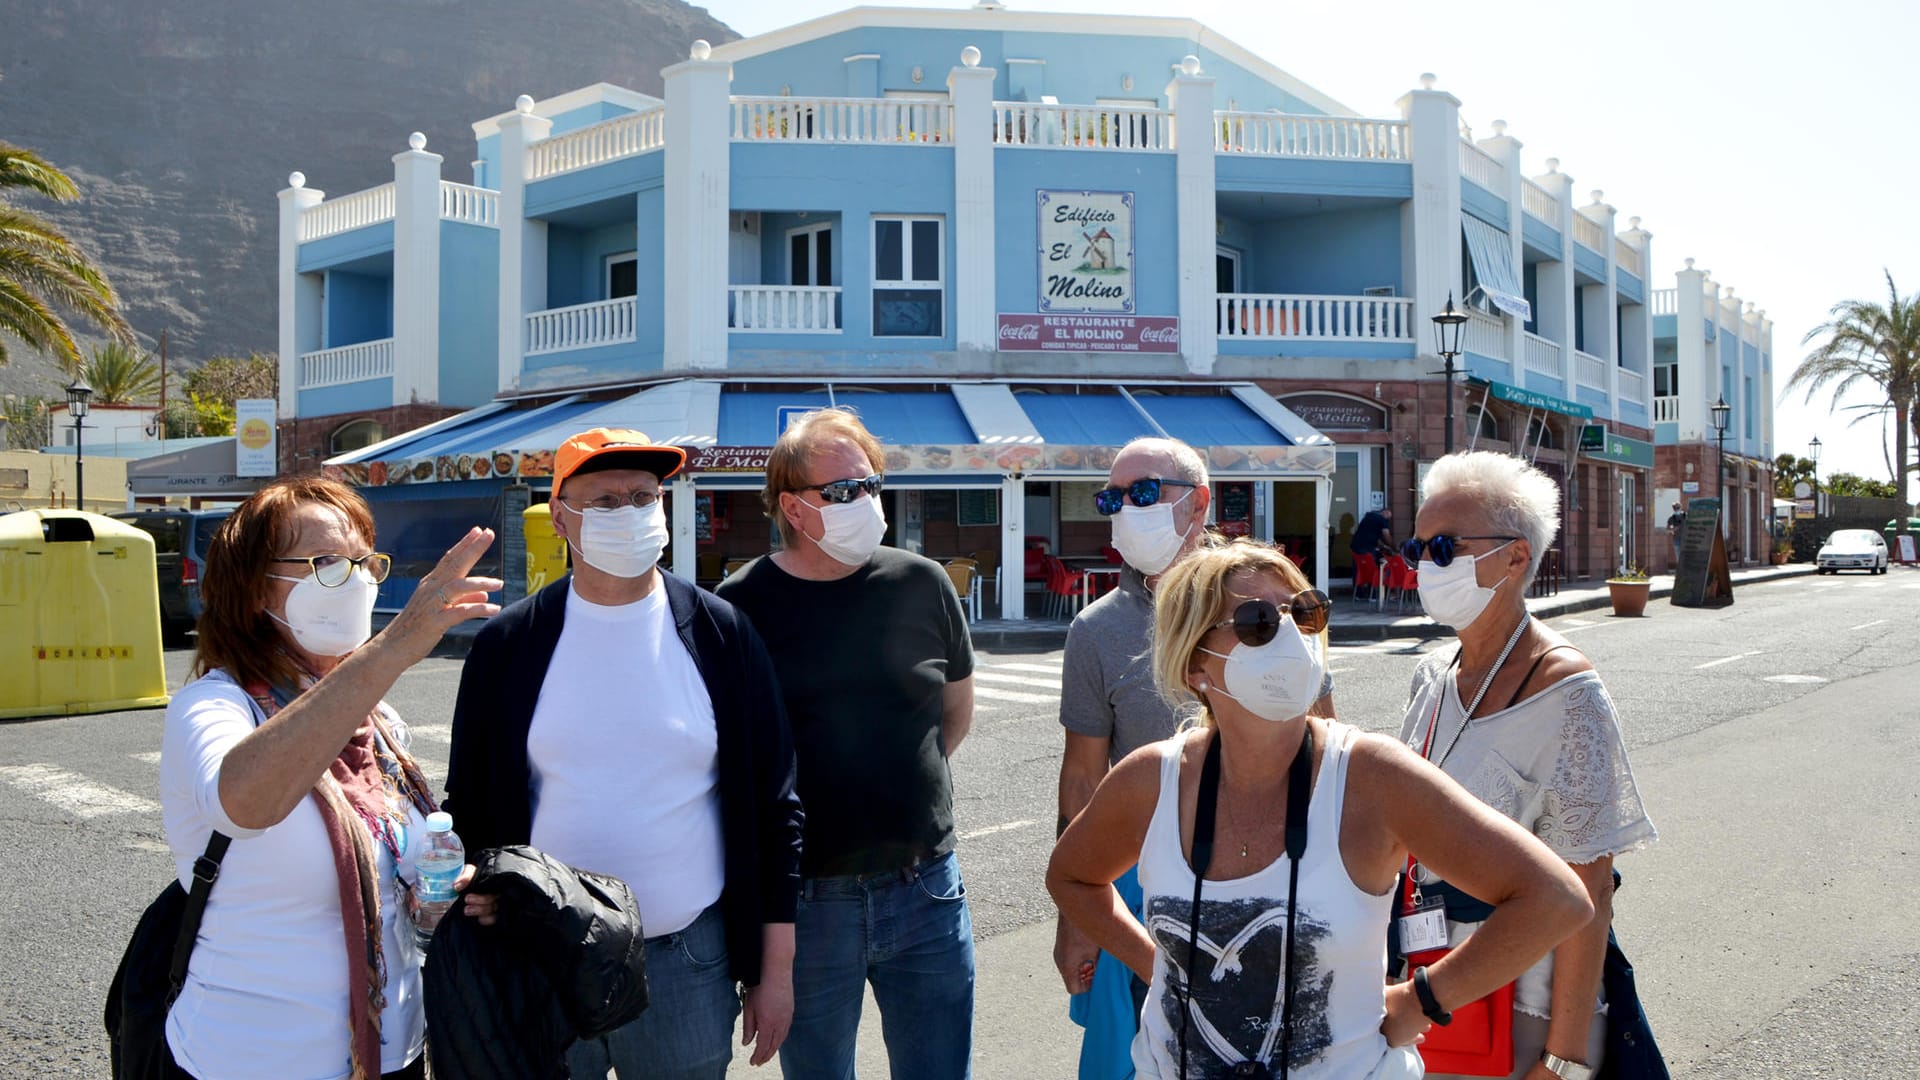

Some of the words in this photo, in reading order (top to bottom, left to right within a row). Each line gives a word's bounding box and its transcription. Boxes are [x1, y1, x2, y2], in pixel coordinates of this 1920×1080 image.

[1054, 205, 1116, 227] Edificio
[1049, 243, 1073, 261] El
[1048, 275, 1124, 298] Molino
[1044, 317, 1136, 328] RESTAURANTE
[1055, 328, 1071, 339] EL
[1074, 328, 1124, 340] MOLINO
[1294, 405, 1365, 415] Restaurante
[1311, 413, 1371, 424] Molino
[701, 447, 770, 457] Restaura
[692, 456, 721, 468] El
[725, 456, 769, 468] Mol
[168, 477, 208, 486] URANTE
